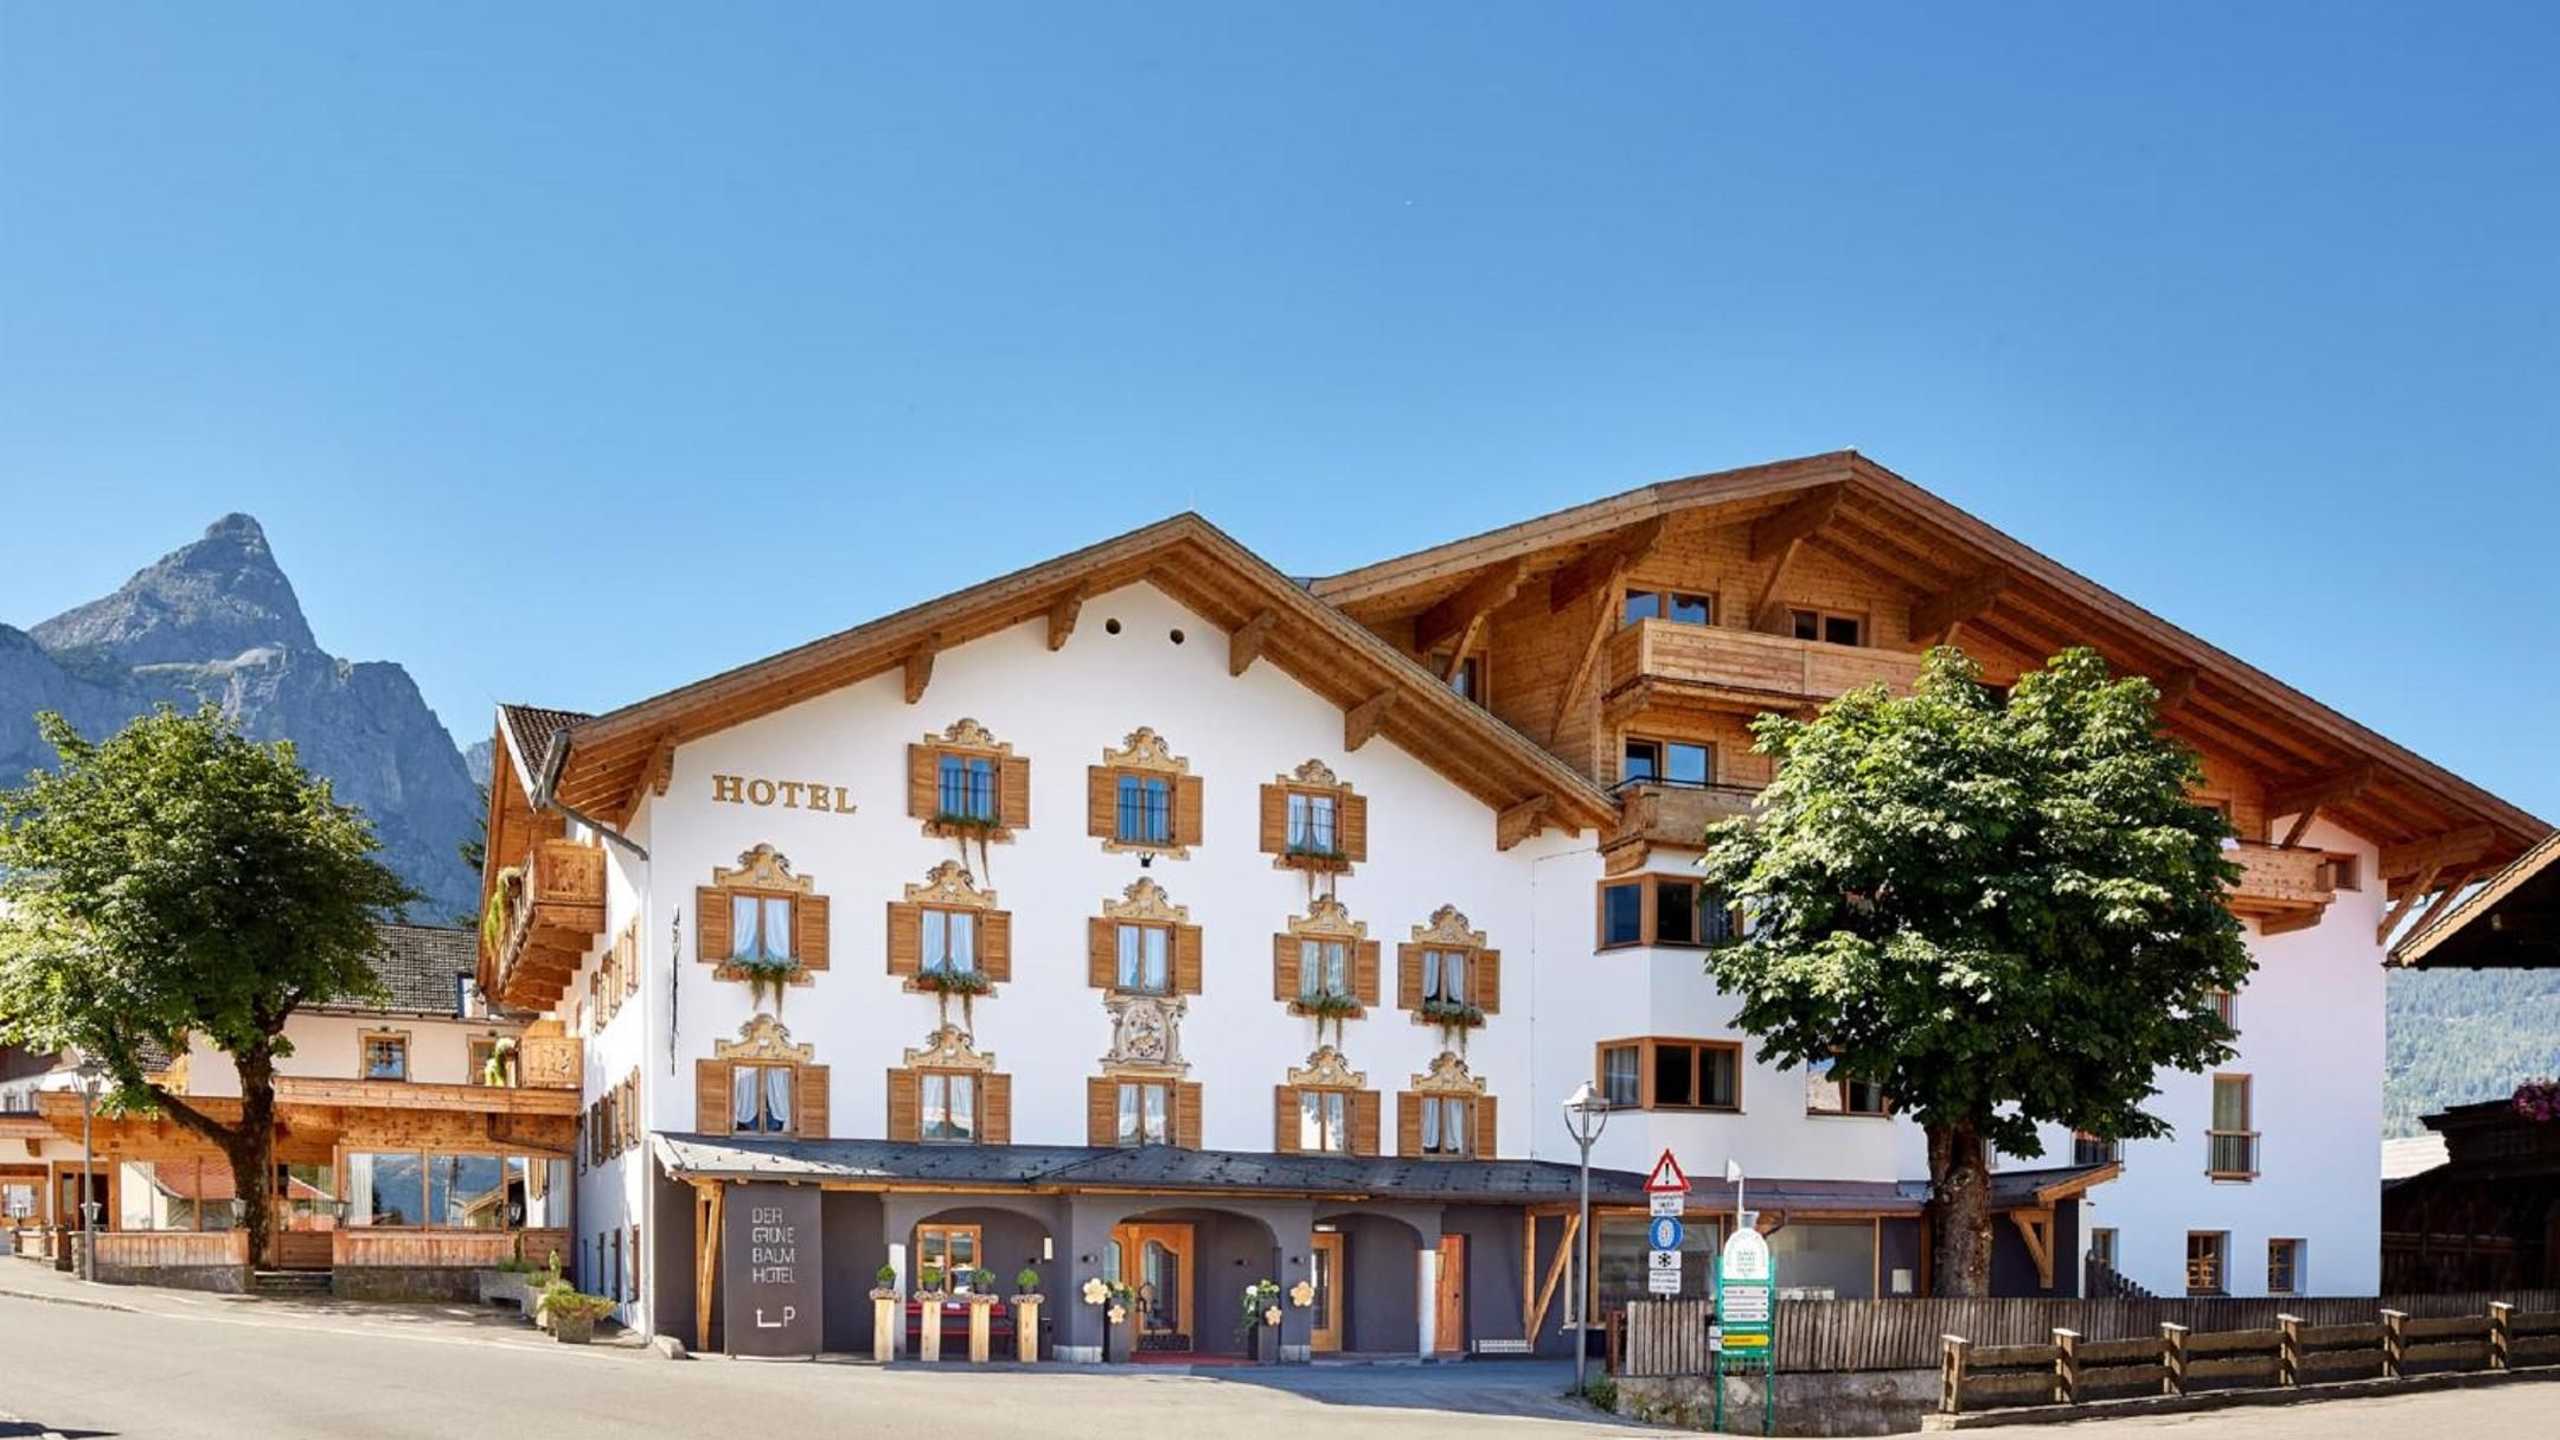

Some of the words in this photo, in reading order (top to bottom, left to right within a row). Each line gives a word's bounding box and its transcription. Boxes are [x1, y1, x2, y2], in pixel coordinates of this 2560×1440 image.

[712, 774, 857, 814] HOTEL
[752, 1207, 782, 1224] DER
[752, 1248, 795, 1263] BAUM
[752, 1267, 795, 1283] HOTEL
[784, 1306, 796, 1328] P
